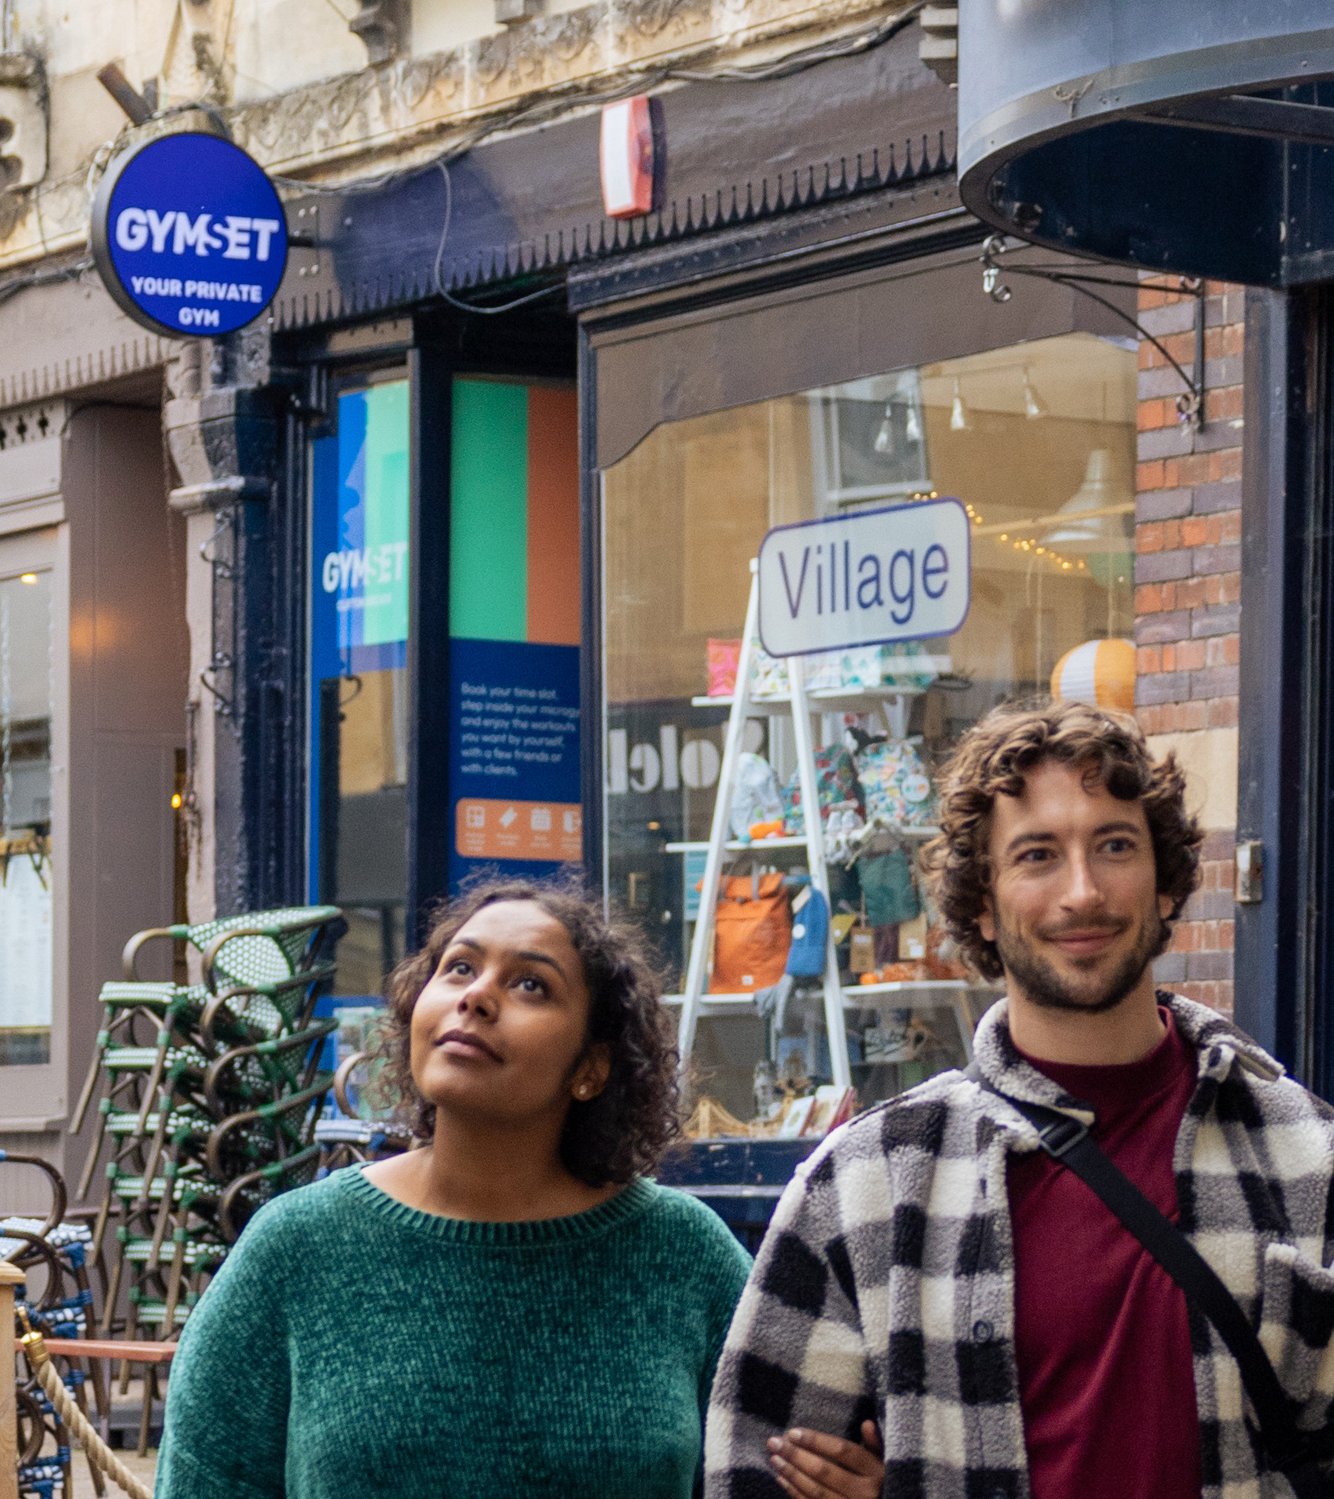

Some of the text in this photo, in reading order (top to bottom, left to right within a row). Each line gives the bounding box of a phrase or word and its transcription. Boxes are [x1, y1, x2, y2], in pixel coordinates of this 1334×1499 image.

[116, 207, 280, 262] GYMSET
[131, 275, 263, 304] YOUR PRIVATE
[178, 307, 221, 328] GYM
[323, 541, 408, 593] GYMSET
[779, 540, 949, 625] Village
[461, 682, 487, 696] Book
[489, 687, 511, 698] your
[514, 687, 536, 699] time
[461, 701, 483, 712] step
[485, 701, 514, 713] inside
[516, 704, 537, 714] your
[461, 716, 576, 732] and enjoy the workouts
[462, 733, 479, 744] you
[481, 733, 506, 744] want
[508, 734, 521, 745] by
[461, 747, 562, 763] with a few friends or
[461, 763, 482, 774] with
